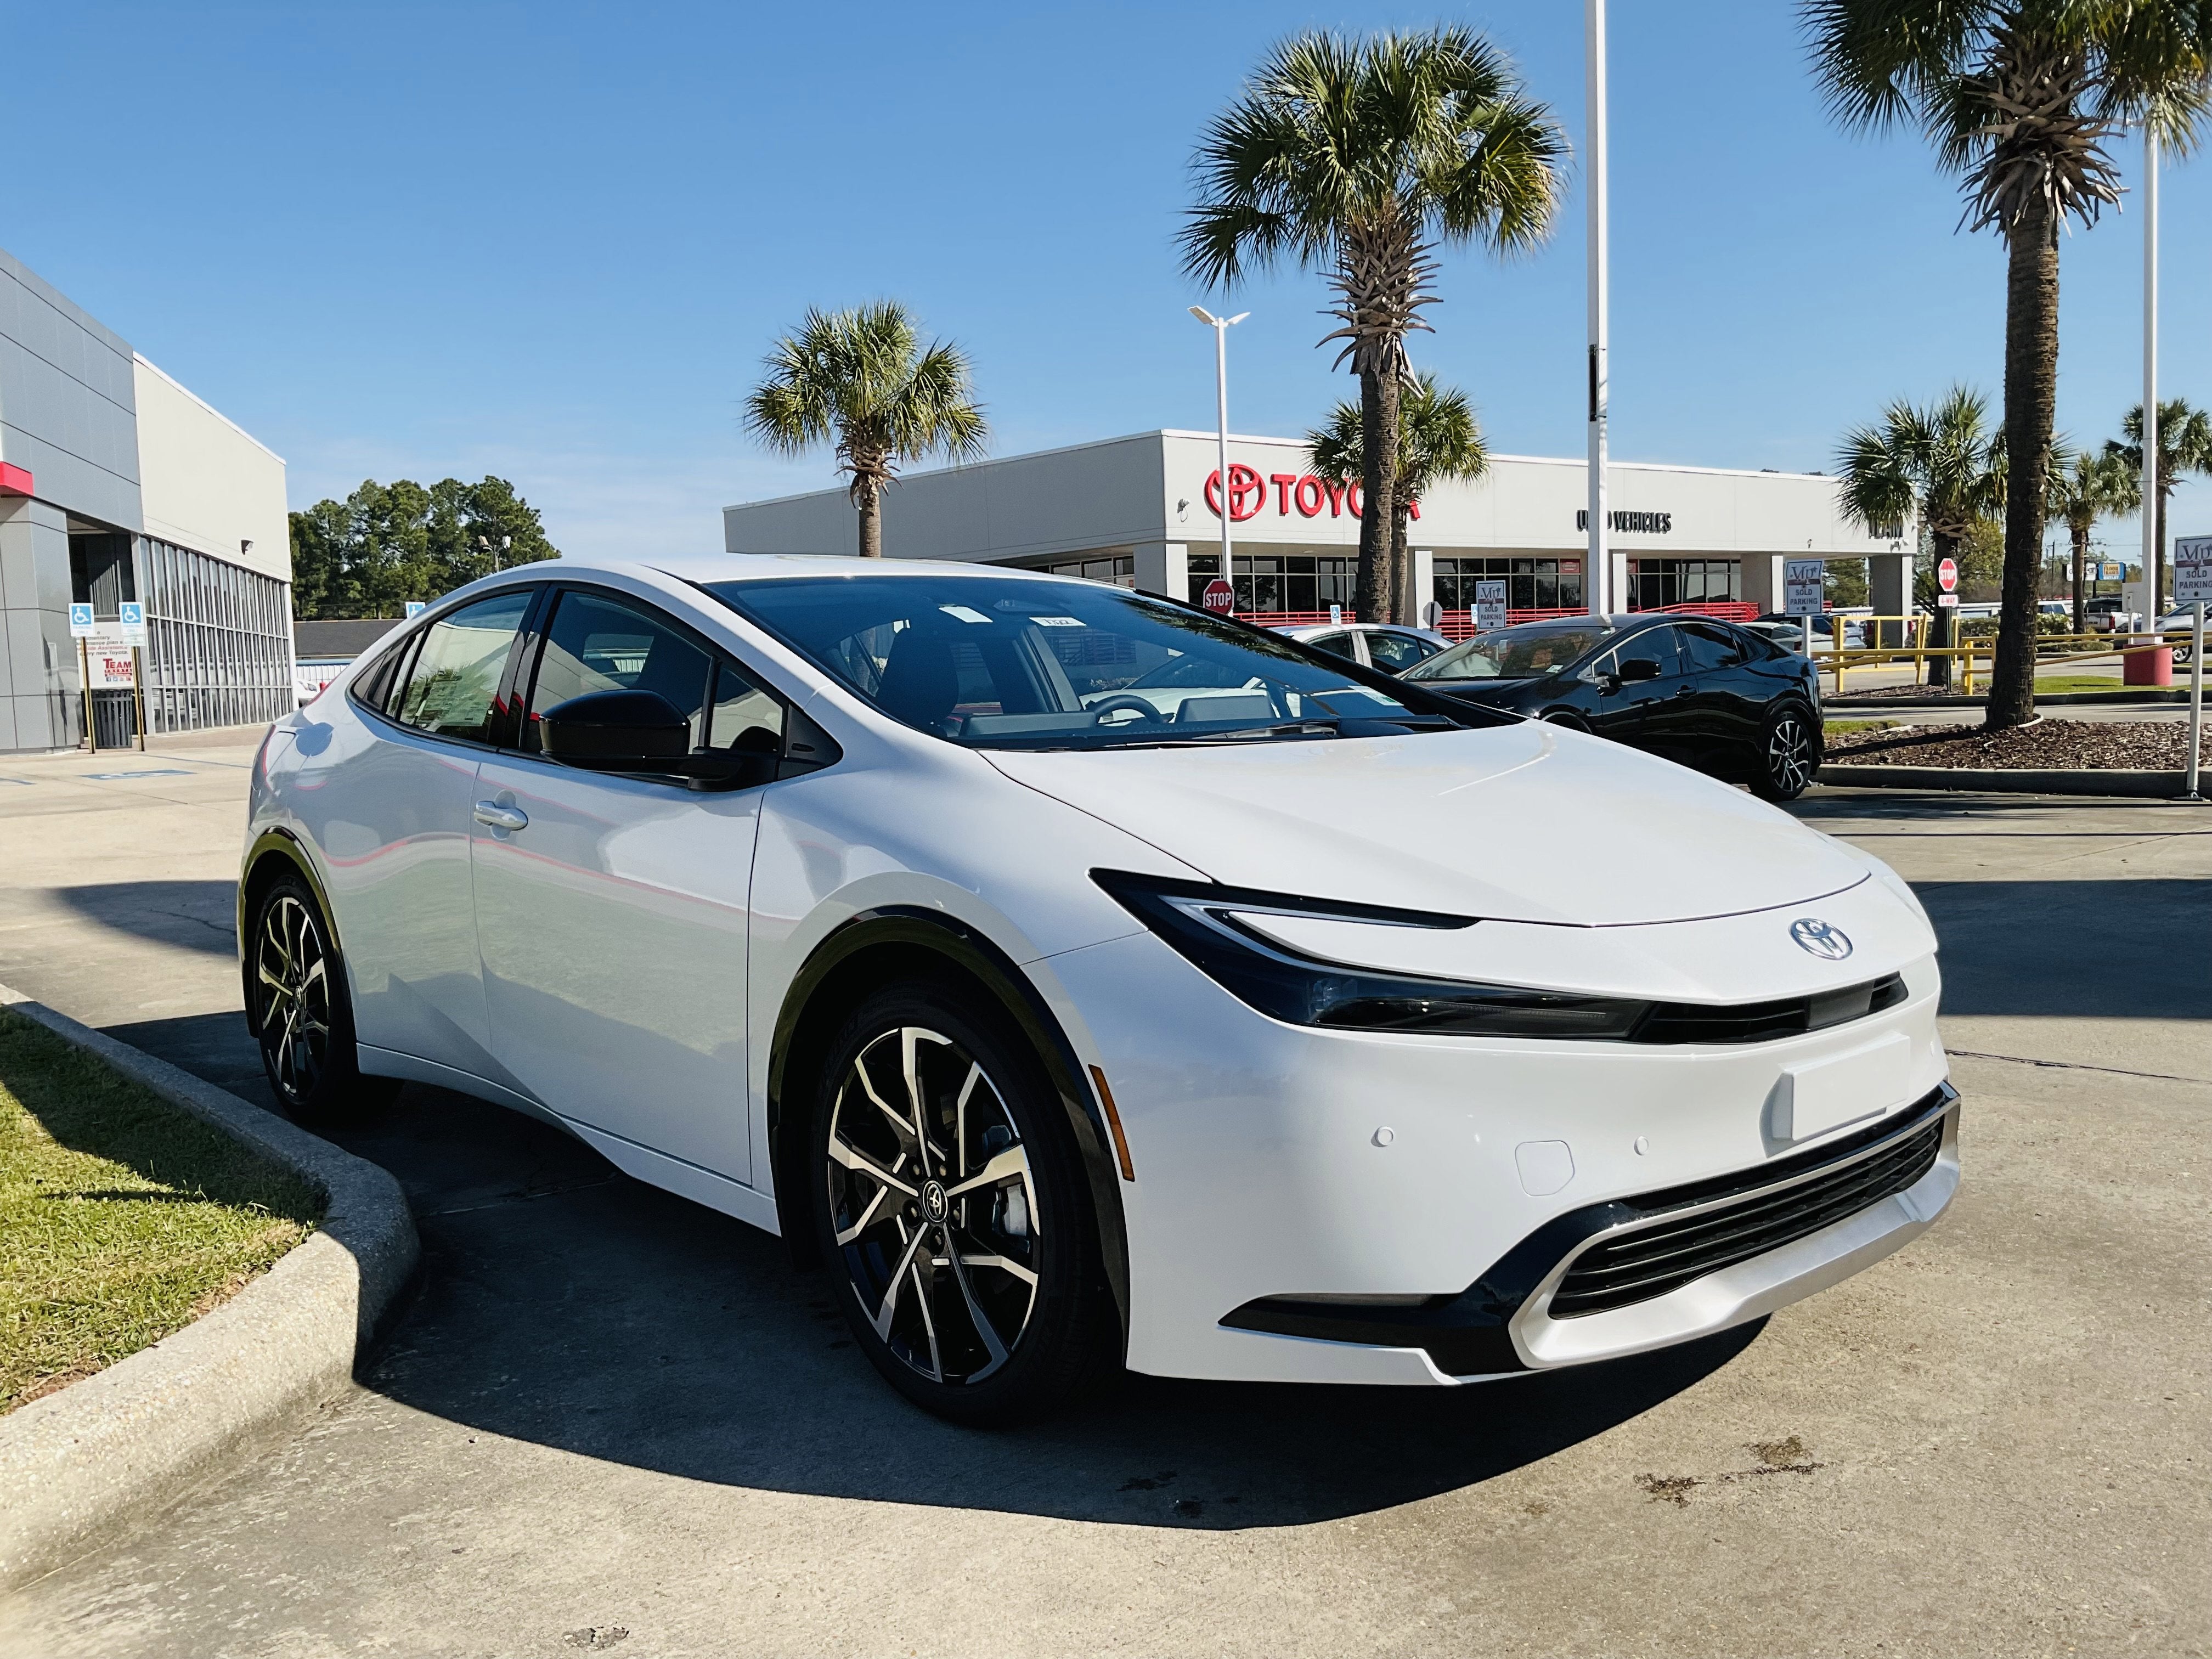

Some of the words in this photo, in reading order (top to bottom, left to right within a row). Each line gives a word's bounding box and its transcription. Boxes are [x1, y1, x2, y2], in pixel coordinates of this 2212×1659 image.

[1271, 473, 1421, 520] TOYO
[1576, 510, 1612, 532] UD
[1613, 511, 1671, 533] VEHICLES
[1940, 569, 1955, 580] STOP
[2186, 570, 2208, 579] SOLD
[1206, 592, 1232, 607] STOP
